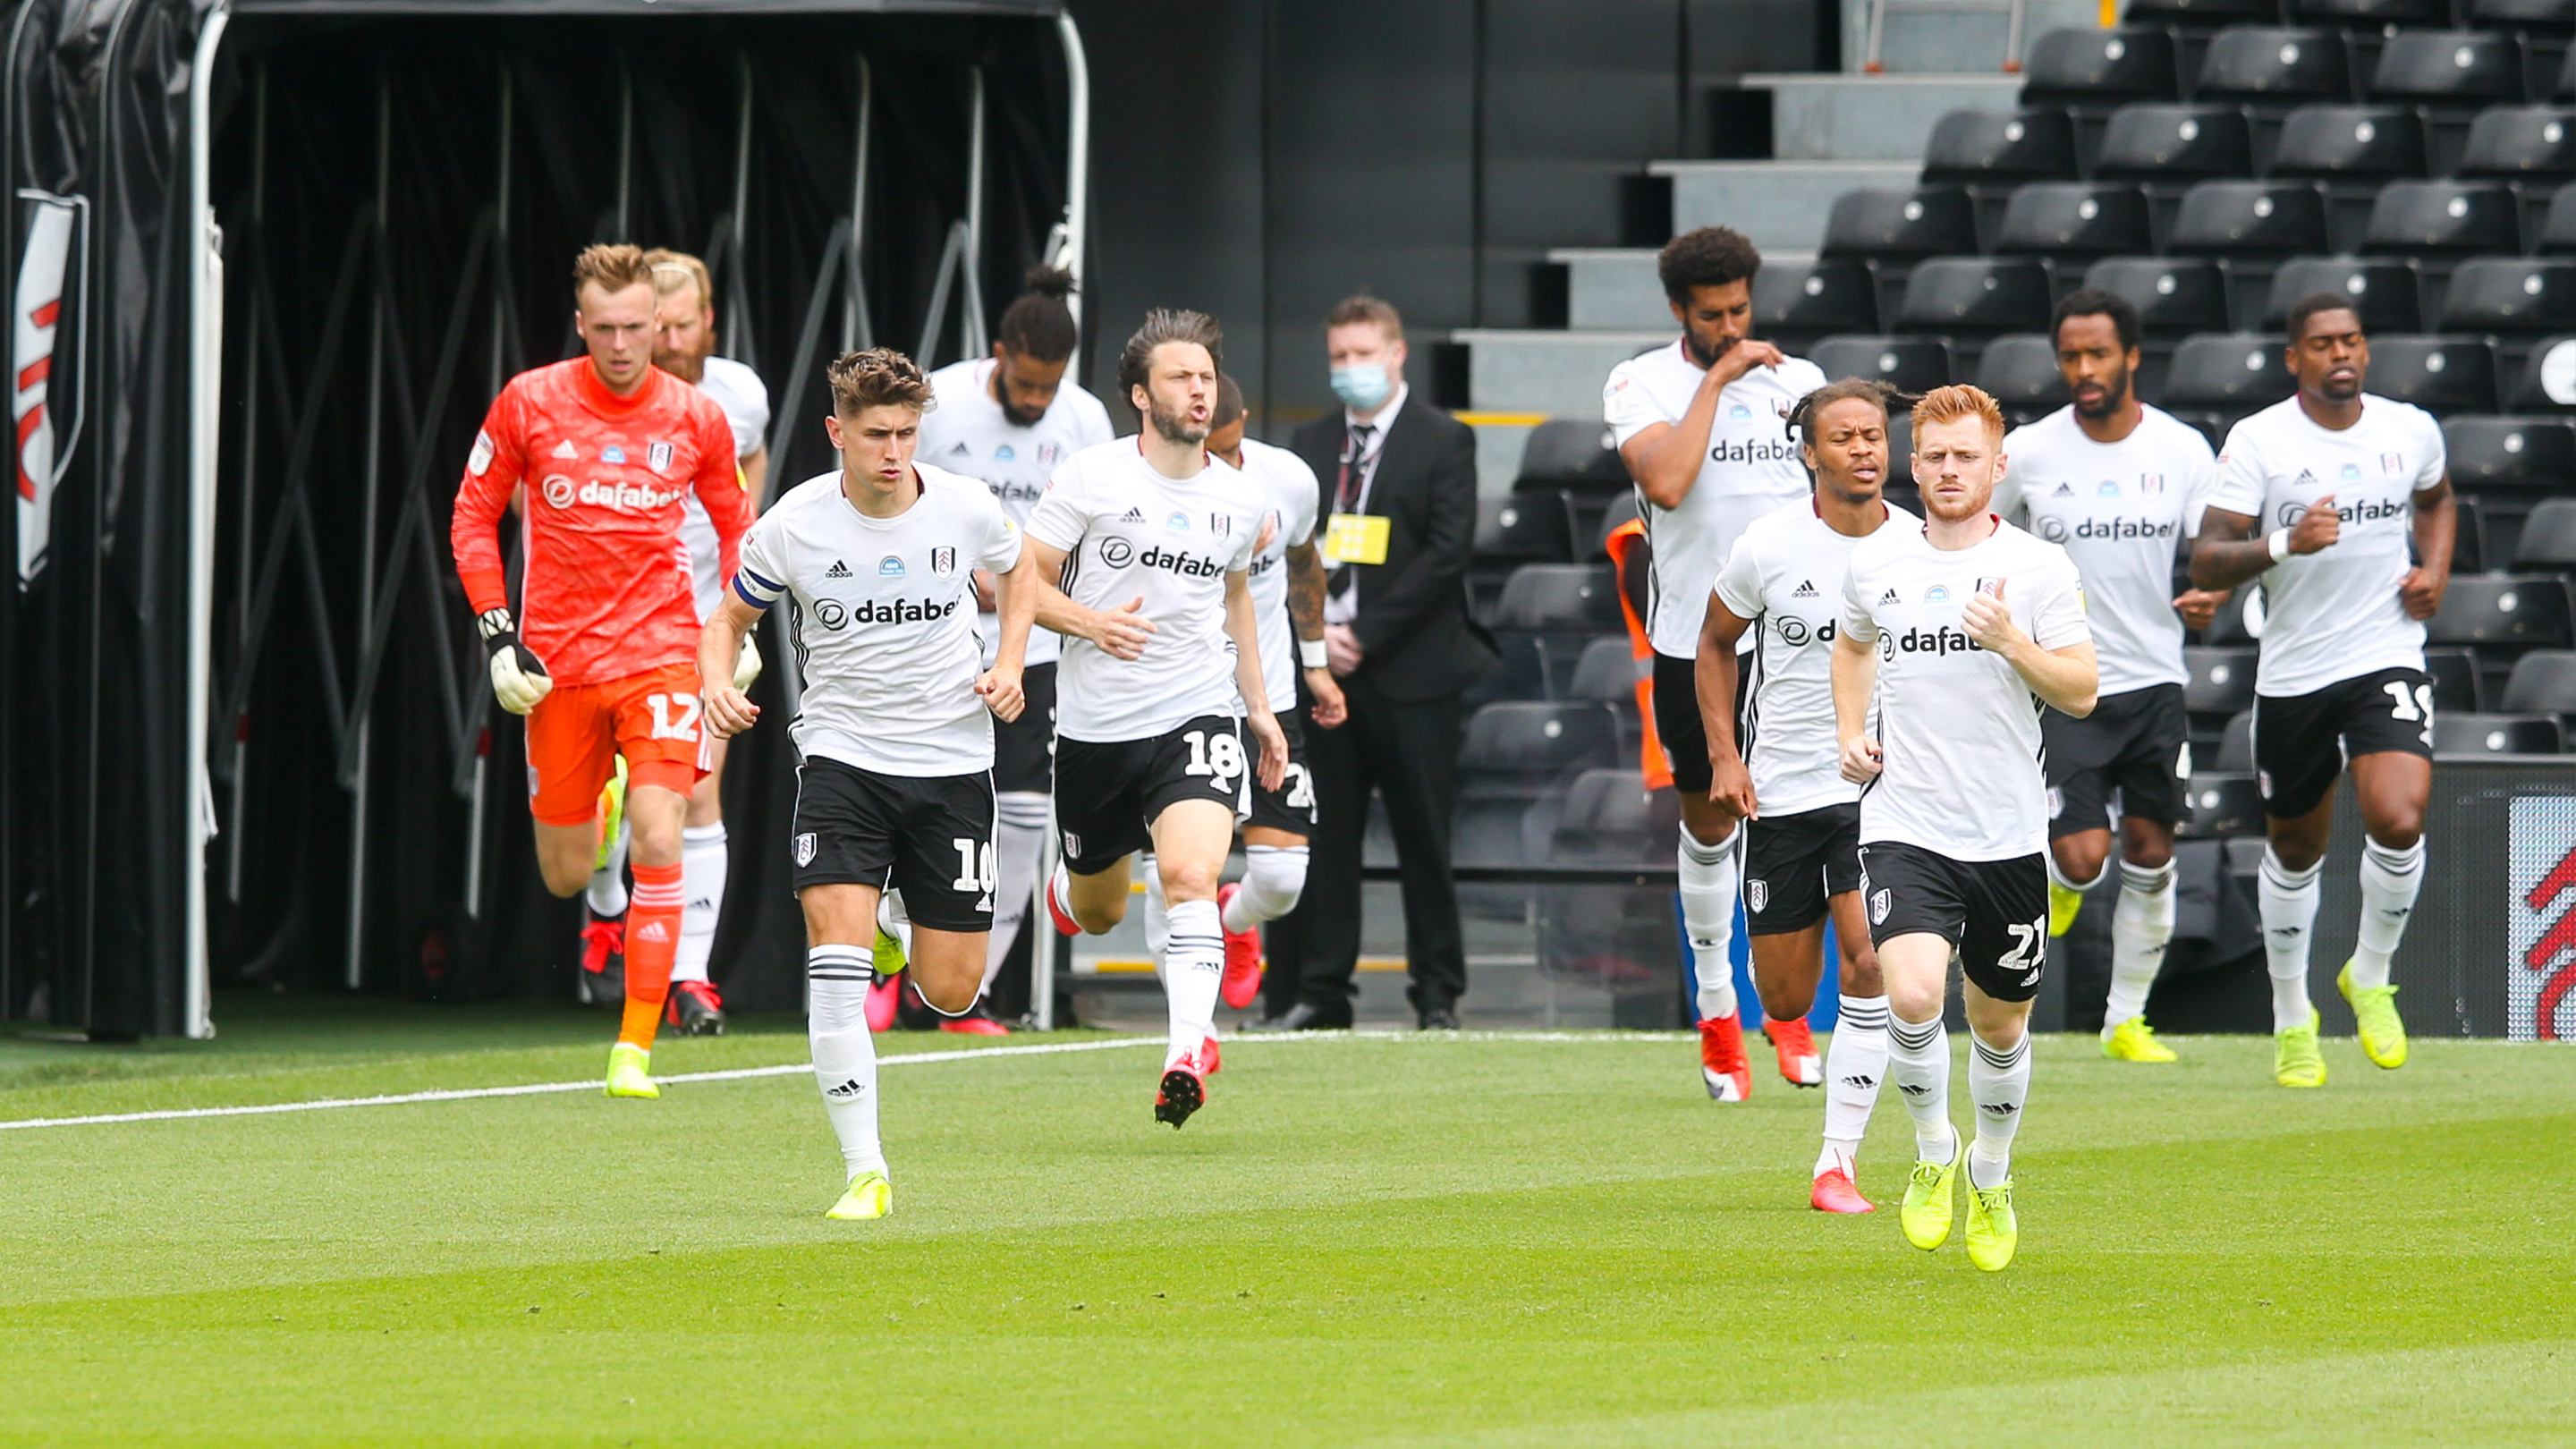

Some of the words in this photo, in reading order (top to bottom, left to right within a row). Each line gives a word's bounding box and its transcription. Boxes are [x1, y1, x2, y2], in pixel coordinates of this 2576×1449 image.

[1711, 437, 1794, 465] dafabe
[2331, 497, 2407, 526] afab
[826, 571, 853, 579] adidas
[1140, 546, 1224, 579] dafabe
[1900, 625, 1985, 657] dafa
[647, 691, 700, 742] 12
[1182, 730, 1243, 778] 18
[1284, 762, 1313, 808] 2
[953, 838, 995, 894] 10
[1997, 914, 2046, 970] 21
